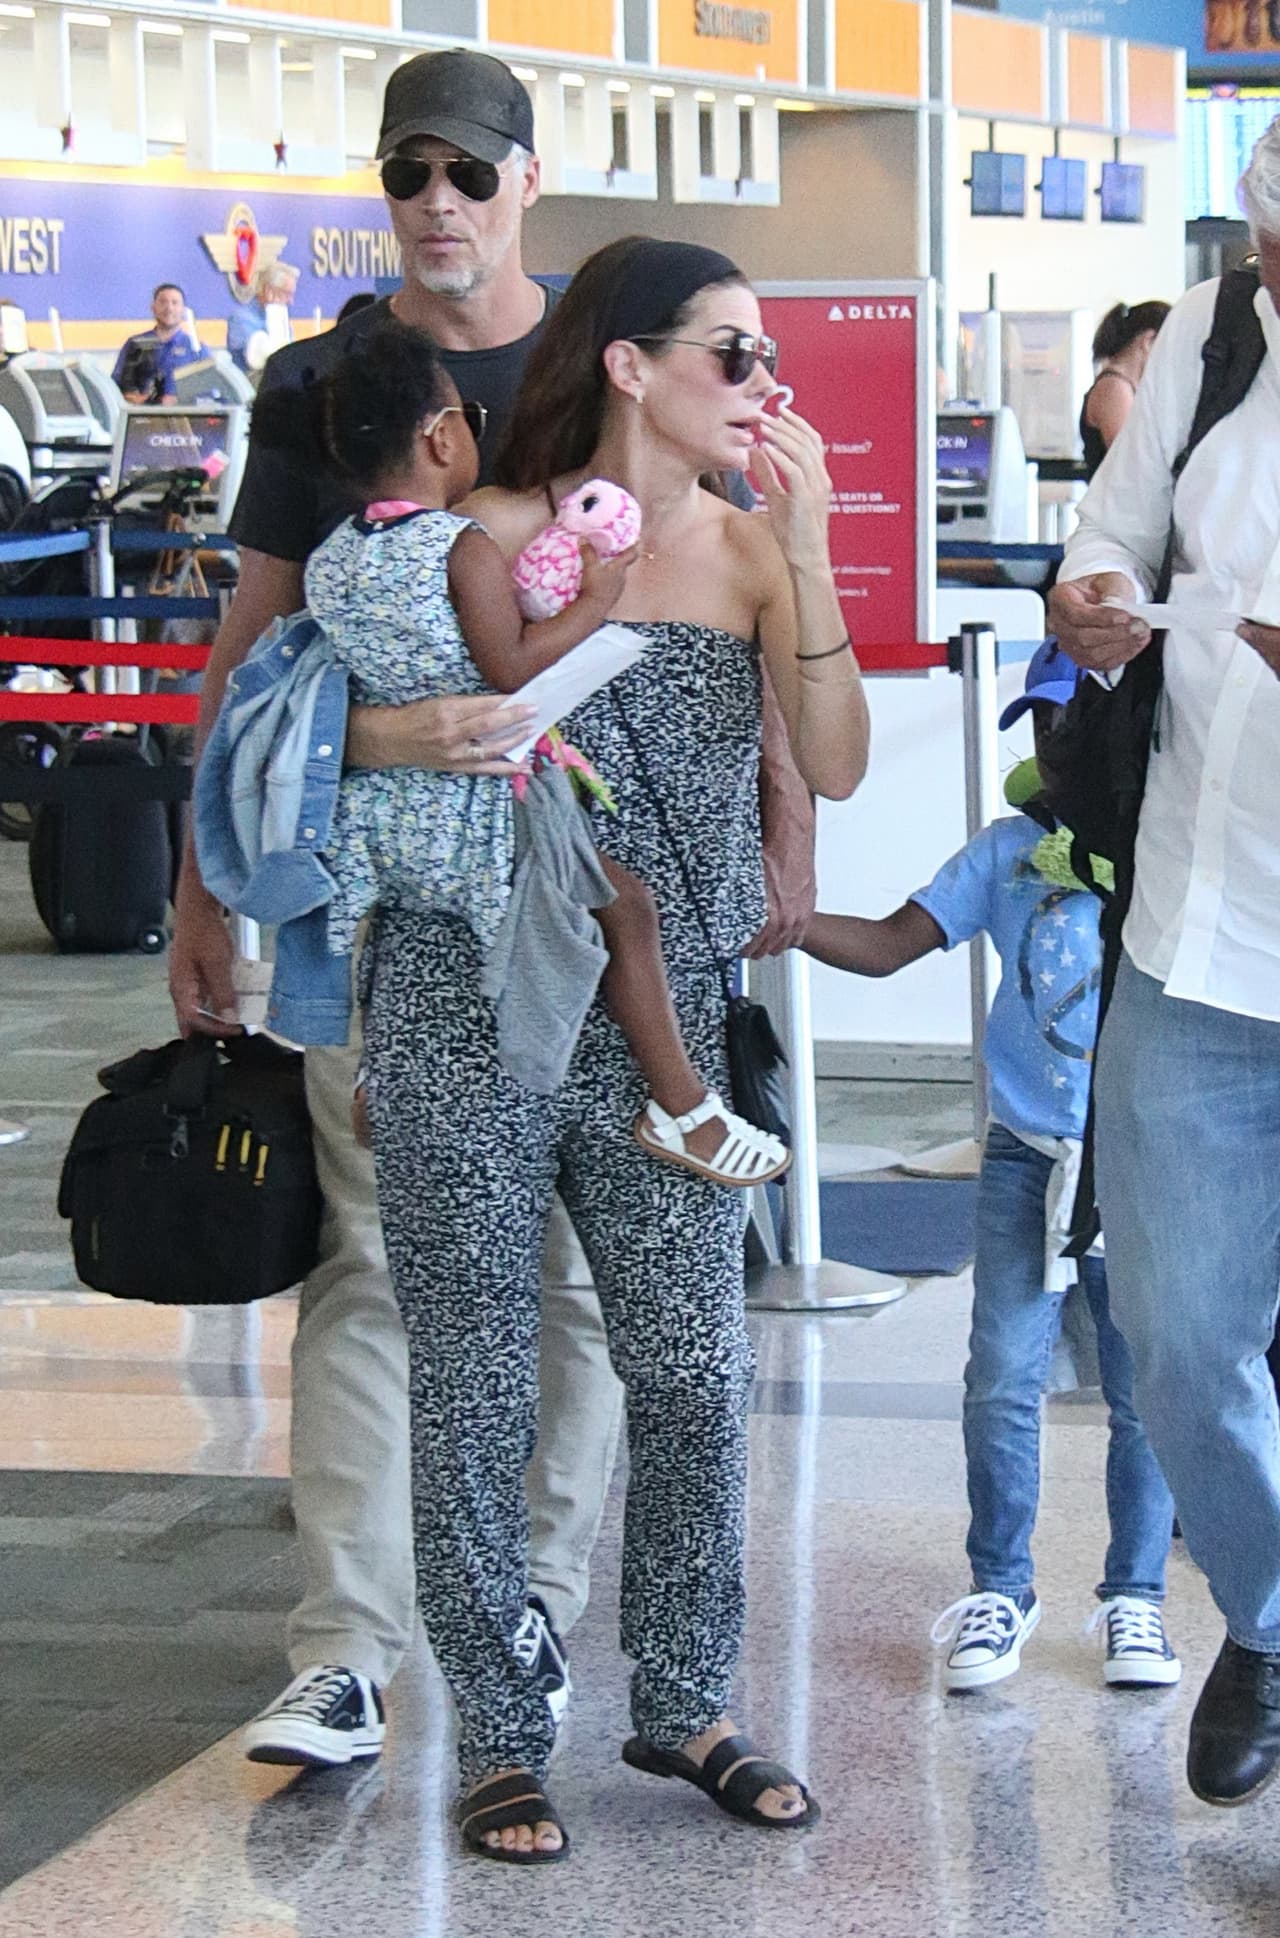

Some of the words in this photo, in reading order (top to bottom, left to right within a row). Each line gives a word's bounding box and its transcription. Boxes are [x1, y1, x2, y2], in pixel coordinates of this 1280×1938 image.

[847, 304, 913, 320] DELTA
[955, 436, 969, 449] IN
[838, 492, 868, 502] SEATS
[869, 492, 884, 502] OR
[842, 503, 901, 514] QUESTIONS?
